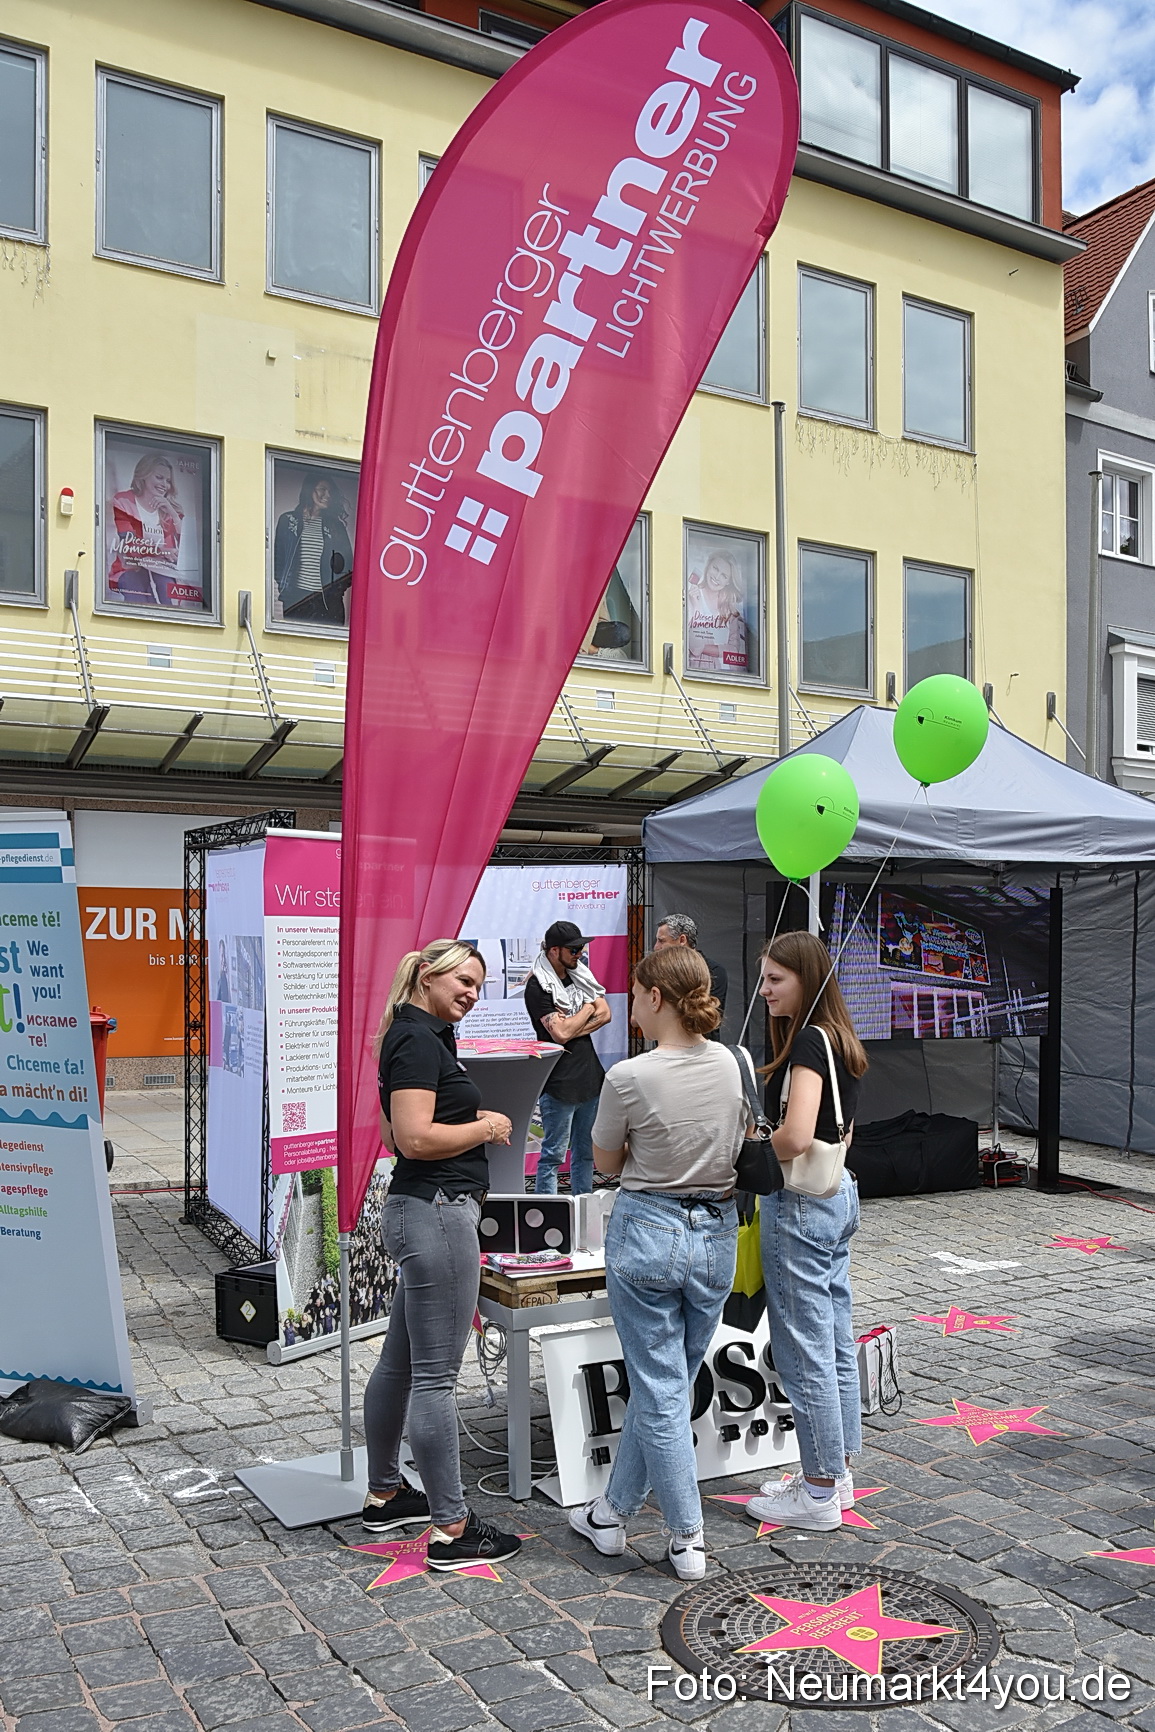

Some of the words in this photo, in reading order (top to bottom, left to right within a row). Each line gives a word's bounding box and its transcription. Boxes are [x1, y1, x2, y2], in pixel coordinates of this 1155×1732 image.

[596, 70, 757, 360] LICHTWERBUNG
[475, 17, 723, 499] partner
[379, 181, 571, 587] guttenberger
[125, 531, 154, 546] Dieser
[170, 585, 199, 598] ADLER
[725, 653, 746, 664] ADLER
[531, 878, 601, 892] guttenberger
[274, 884, 311, 907] Wir
[567, 889, 620, 902] partner
[567, 902, 606, 911] lichtwerbung
[0, 914, 38, 927] ceme
[42, 911, 61, 928] tě!
[85, 907, 158, 941] ZUR
[168, 908, 208, 941] M
[27, 940, 49, 956] We
[282, 950, 333, 958] Montagedisponent
[149, 954, 166, 966] bis
[29, 963, 65, 979] want
[32, 983, 61, 1002] you!
[285, 1031, 311, 1039] Schreiner
[285, 1042, 311, 1050] Elektriker
[312, 1040, 330, 1048] m/w/d
[7, 1054, 60, 1074] Chceme
[64, 1058, 85, 1075] ťa!
[285, 1054, 311, 1062] Lackierer
[286, 1075, 316, 1083] mitarbeiter
[69, 1086, 88, 1103] di!
[286, 1086, 313, 1094] Monteure
[0, 1205, 48, 1218] Alltagshilfe
[0, 1226, 42, 1240] Beratung
[244, 1303, 253, 1317] 2
[789, 1605, 851, 1636] PERSONAL-
[808, 1610, 865, 1640] REFERENT
